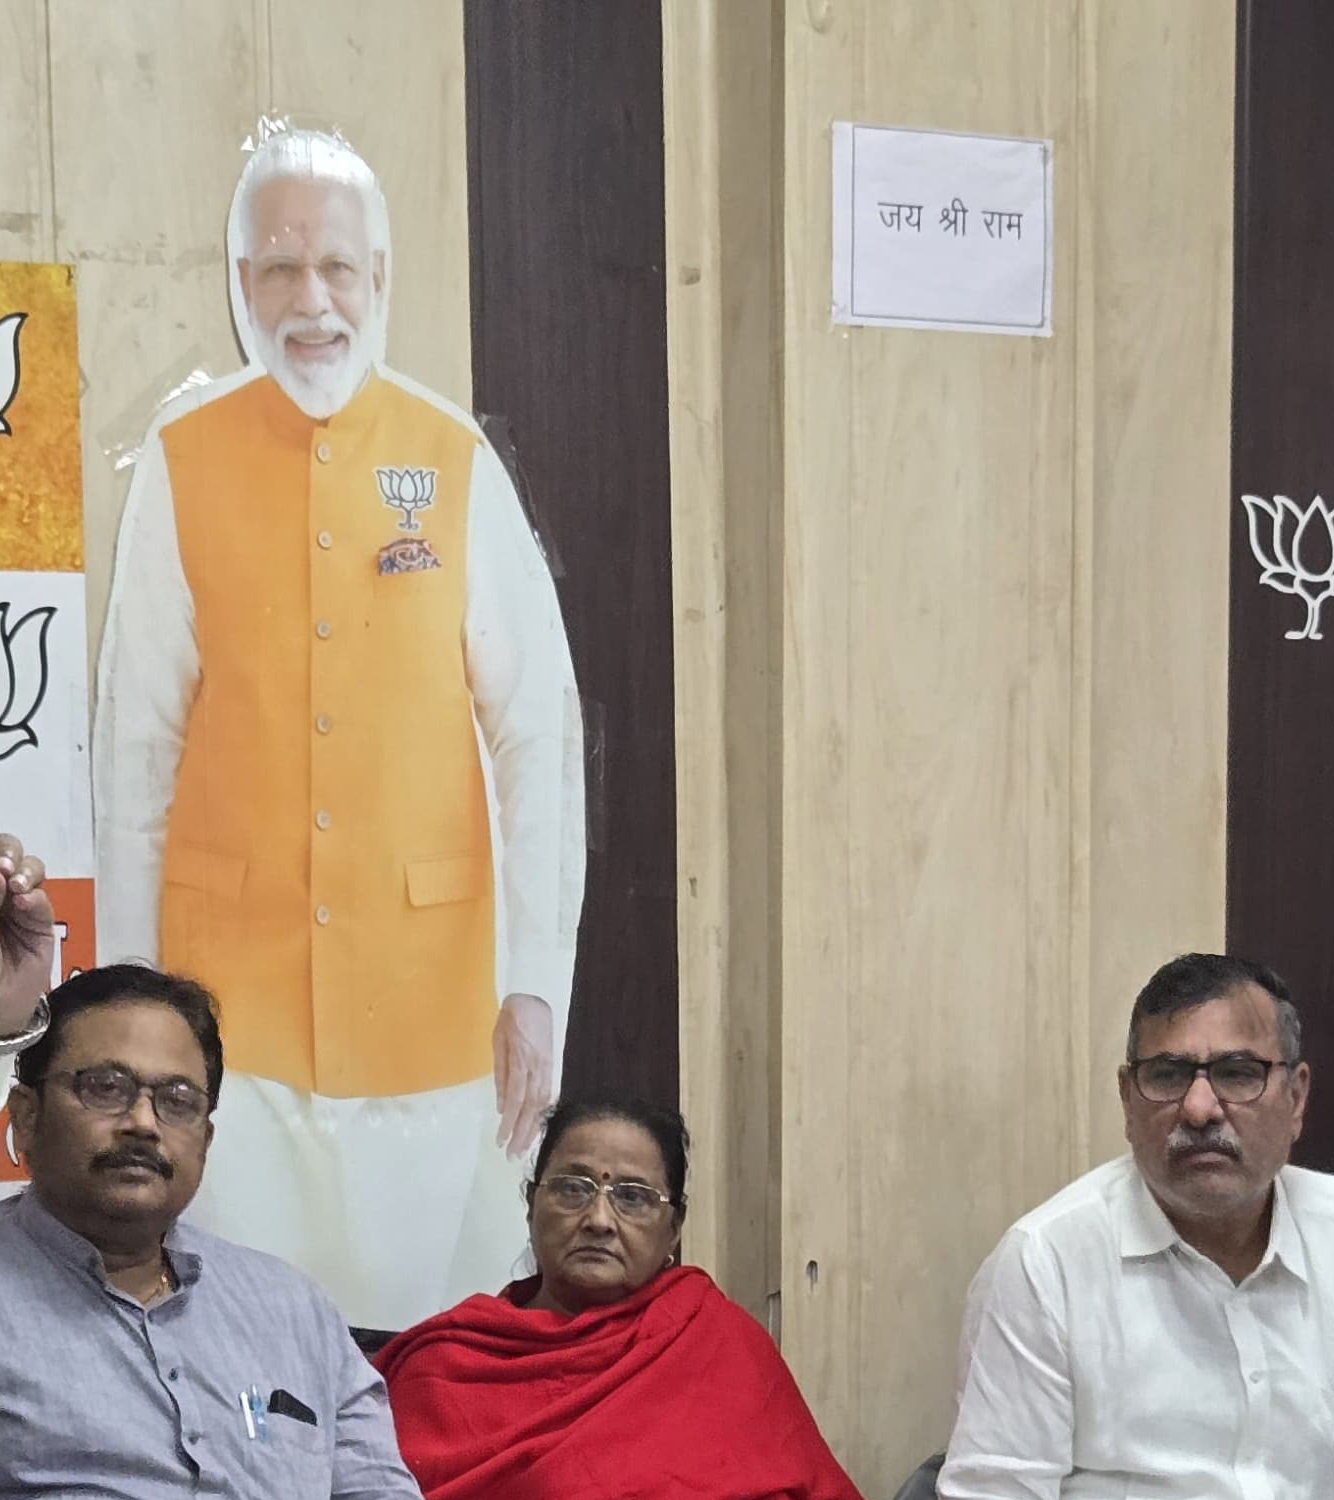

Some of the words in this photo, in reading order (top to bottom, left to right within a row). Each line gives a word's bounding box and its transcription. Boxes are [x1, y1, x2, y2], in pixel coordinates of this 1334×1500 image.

[877, 201, 923, 232] जय
[938, 197, 969, 236] श्री
[981, 210, 1024, 240] राम
